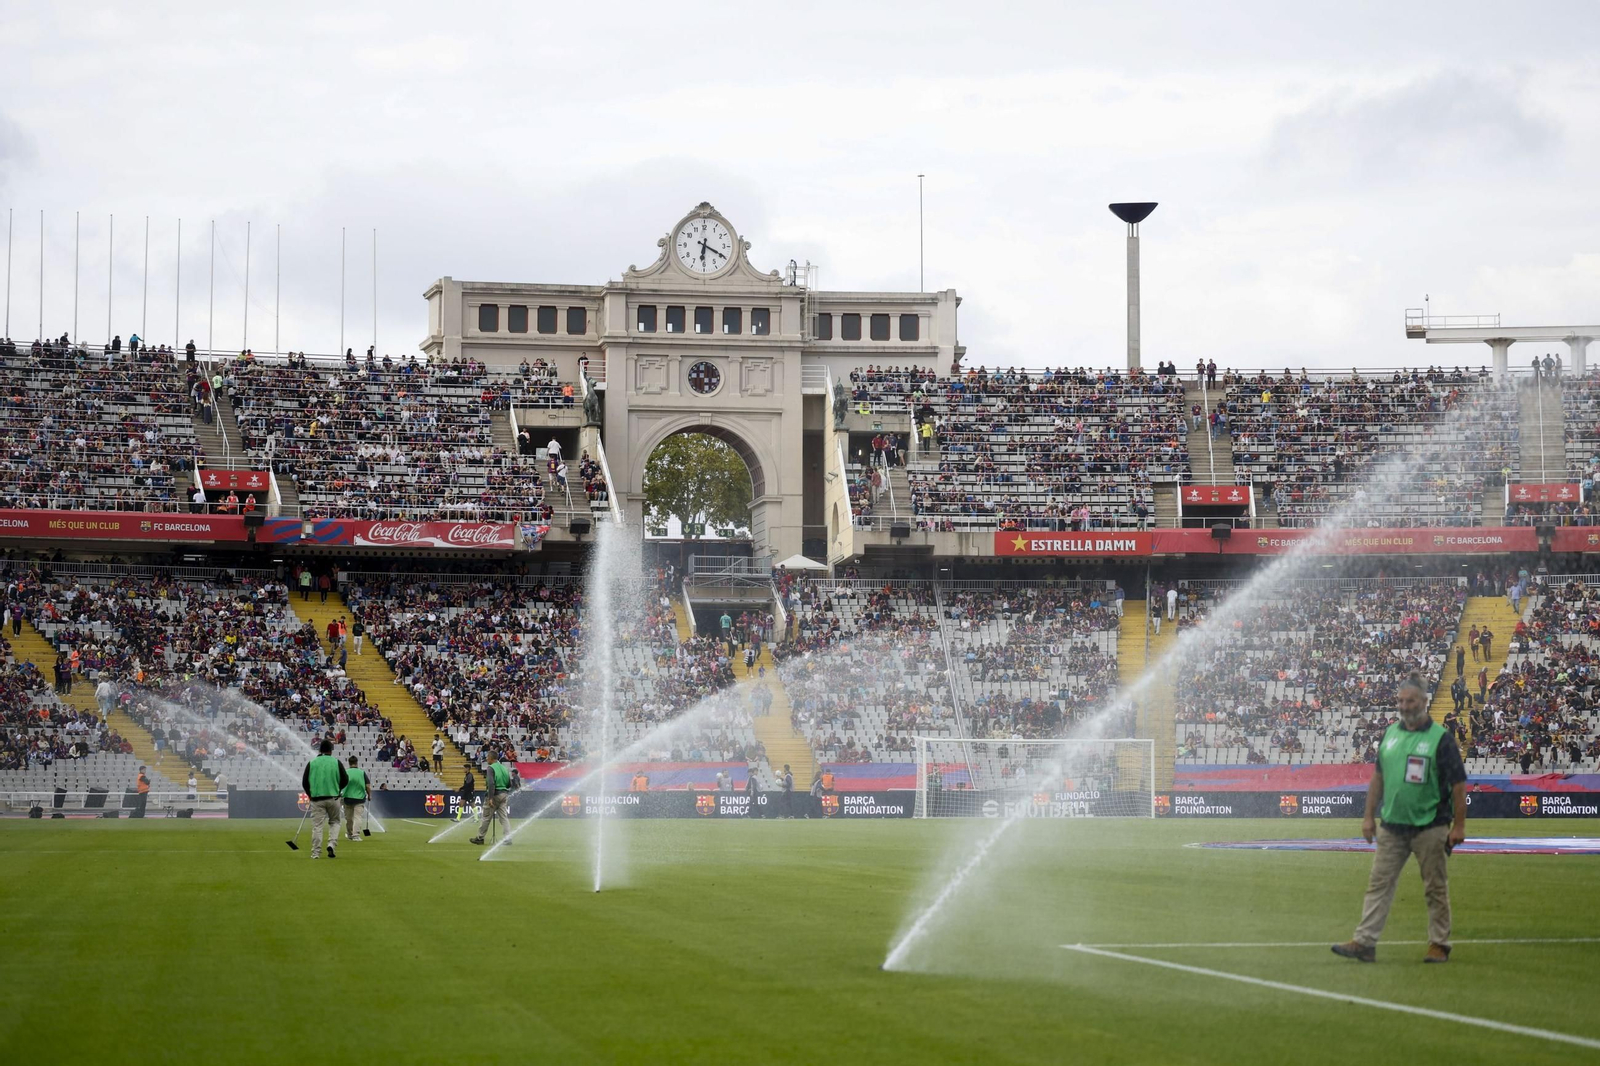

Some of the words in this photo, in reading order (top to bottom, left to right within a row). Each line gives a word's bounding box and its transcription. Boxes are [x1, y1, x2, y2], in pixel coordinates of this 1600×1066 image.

[49, 519, 67, 529] MÉS
[68, 521, 84, 530] QUE
[86, 521, 98, 530] UN
[99, 521, 120, 530] CLUB
[153, 522, 163, 531] FC
[164, 523, 211, 532] BARCELONA
[1270, 539, 1280, 547] FC
[1363, 538, 1379, 546] QUE
[1393, 537, 1413, 545] CLUB
[1457, 536, 1503, 544] BARCELONA
[1031, 539, 1091, 551] ESTRELLA
[1095, 540, 1136, 551] DAMM
[585, 794, 640, 804] FUNDACIÓN
[844, 796, 875, 806] BARÇA
[1175, 797, 1205, 806] BARÇA
[1302, 794, 1353, 804] FUNDACIÓN
[1542, 796, 1571, 806] BARÇA
[844, 806, 904, 815] FOUNDATION
[1175, 806, 1232, 814] FOUNDATION
[1302, 806, 1331, 815] BARÇA
[1542, 806, 1598, 814] FOUNDATION
